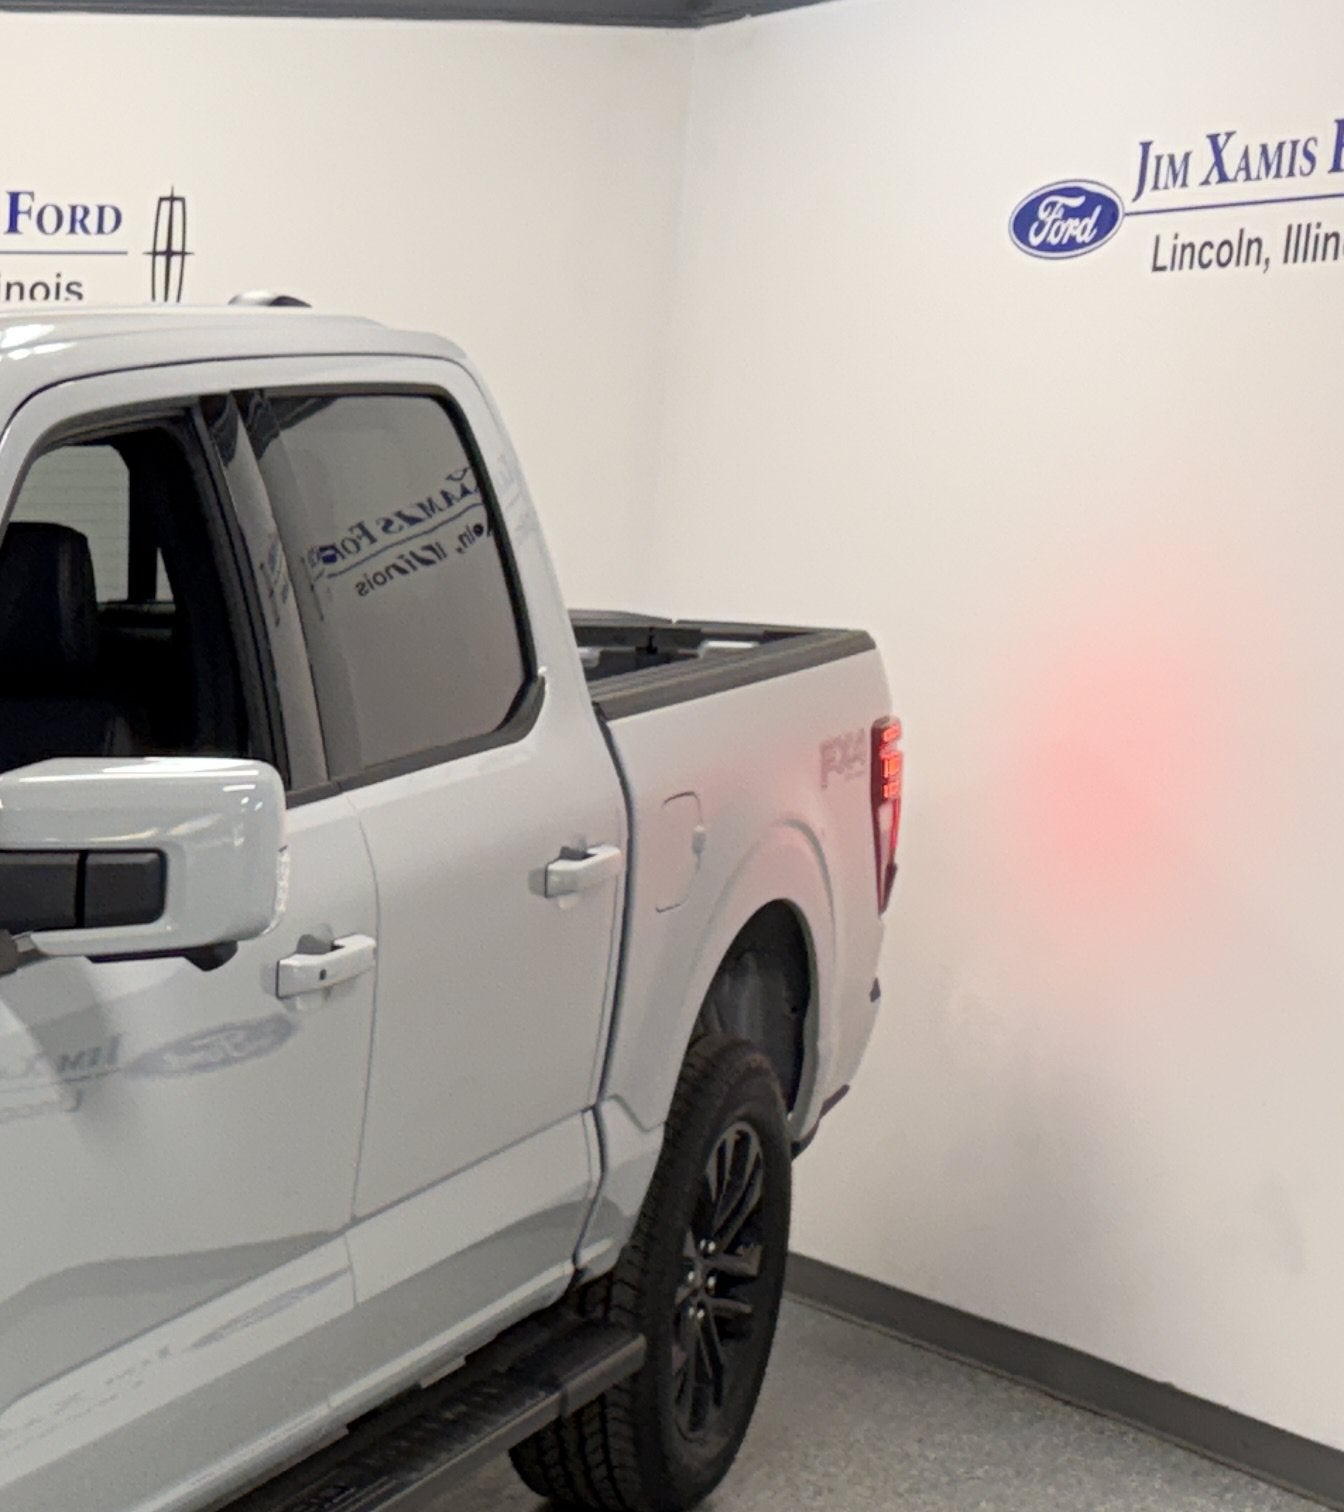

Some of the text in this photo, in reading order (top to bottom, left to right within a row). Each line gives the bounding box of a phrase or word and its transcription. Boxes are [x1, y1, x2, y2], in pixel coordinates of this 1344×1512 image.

[1028, 194, 1103, 247] Ford
[1151, 221, 1344, 274] Lincoln, Illin
